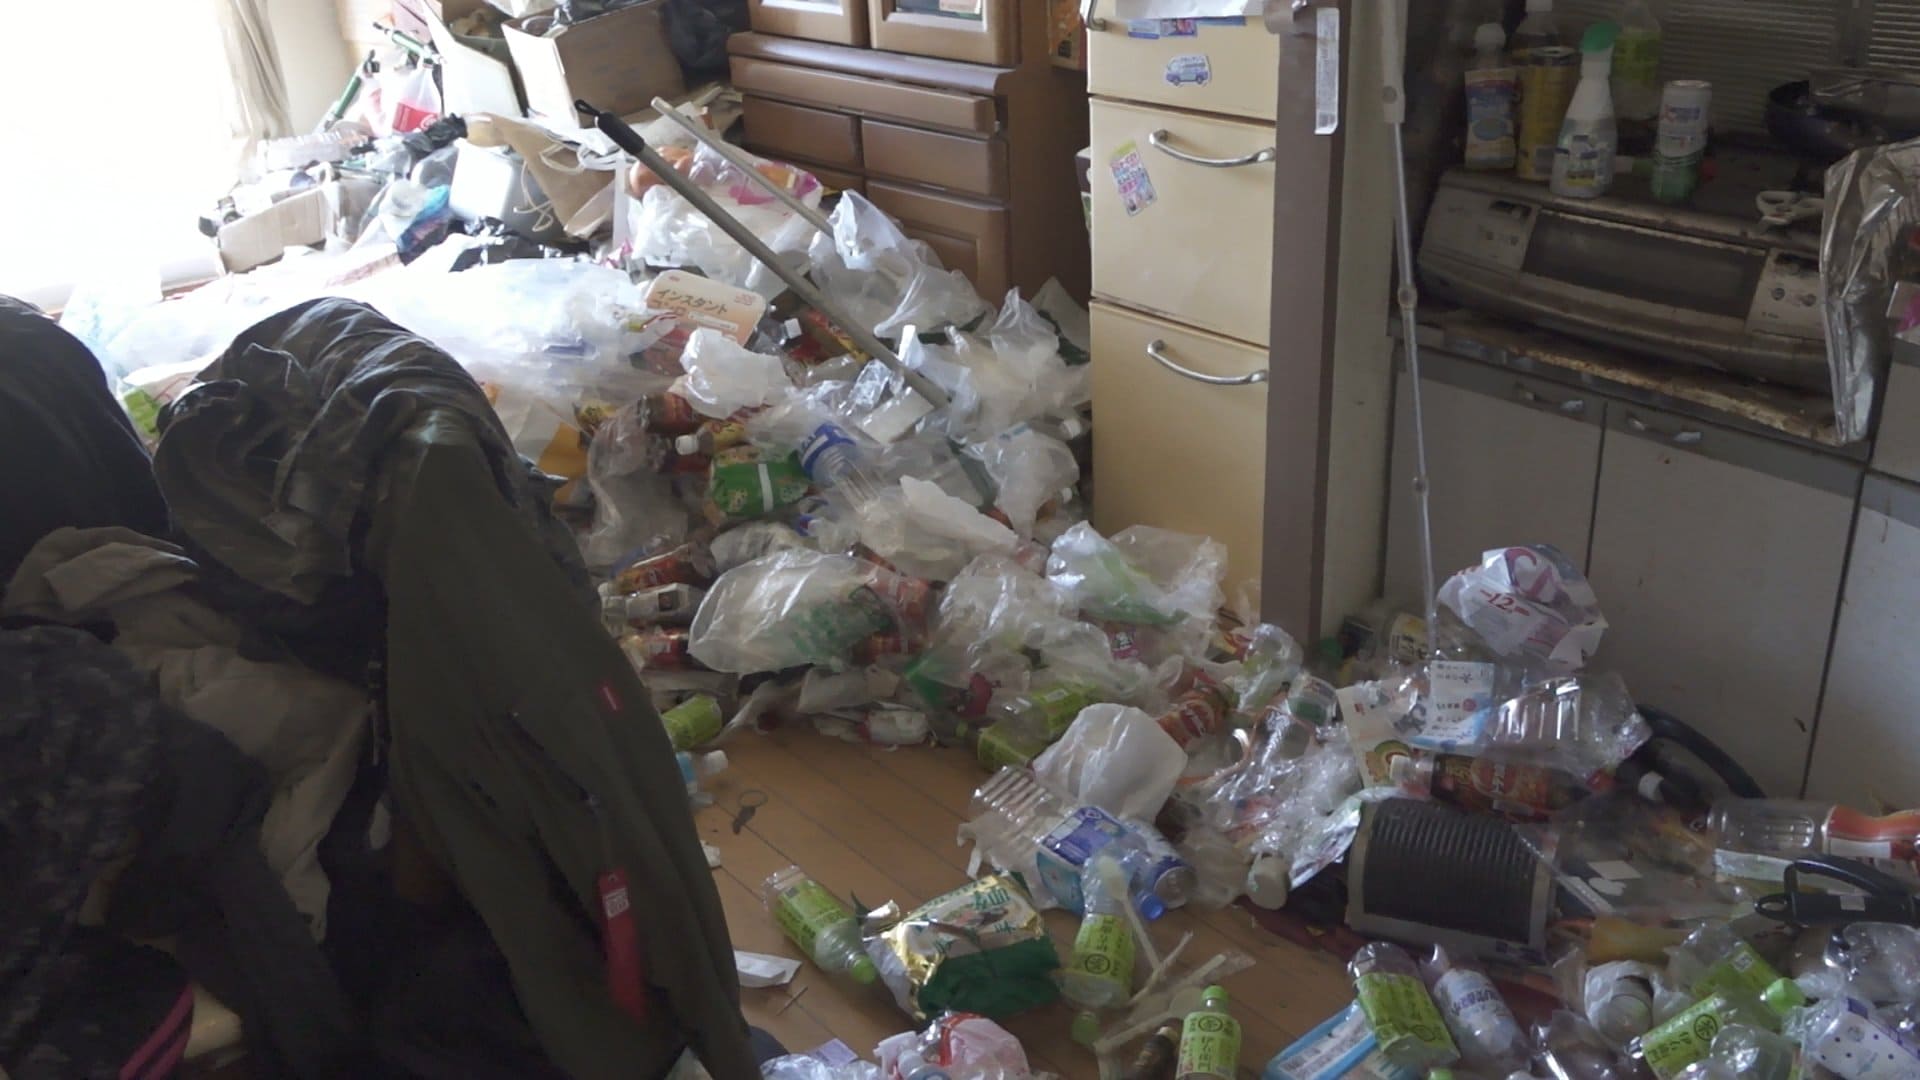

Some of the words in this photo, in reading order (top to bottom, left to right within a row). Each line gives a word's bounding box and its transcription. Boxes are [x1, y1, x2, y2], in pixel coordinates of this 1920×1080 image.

[656, 287, 728, 315] インスタント
